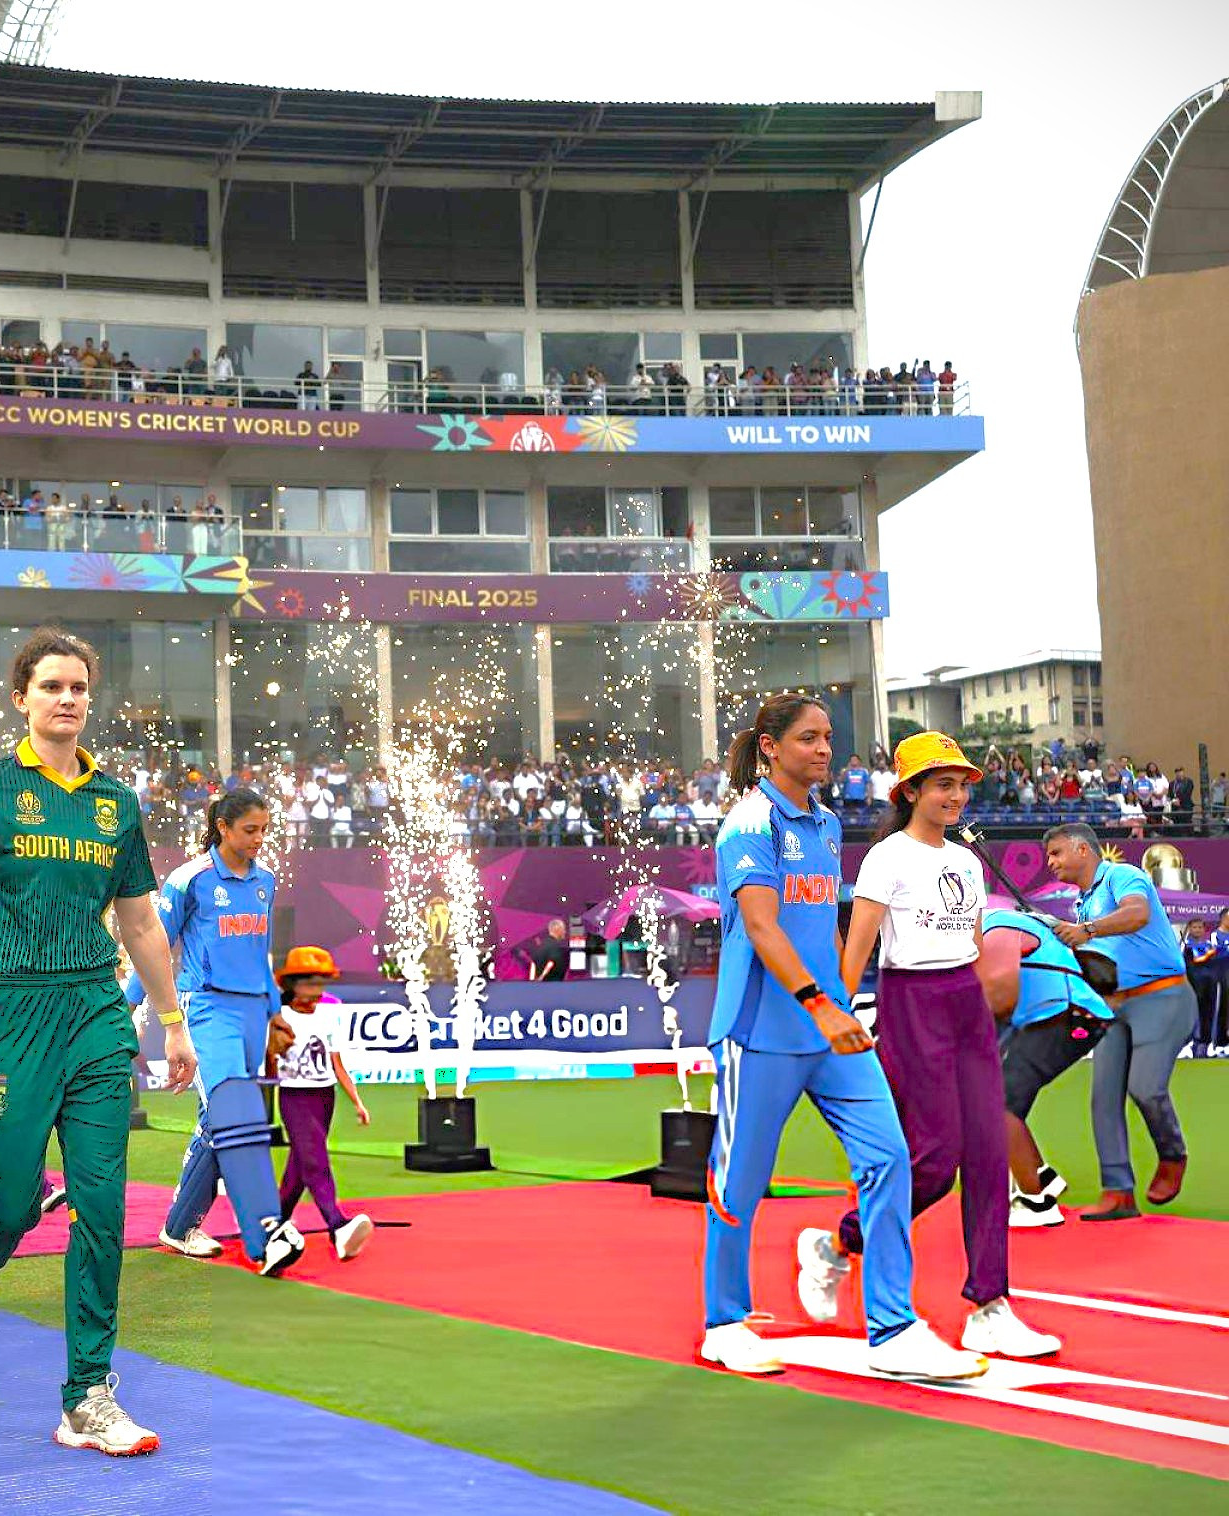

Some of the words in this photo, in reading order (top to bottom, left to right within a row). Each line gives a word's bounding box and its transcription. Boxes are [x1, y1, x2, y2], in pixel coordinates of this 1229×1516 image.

[27, 407, 132, 428] WOMEN'S
[137, 412, 227, 433] CRICKET
[233, 416, 312, 436] WORLD
[318, 420, 361, 438] CUP
[726, 426, 783, 444] WILL
[785, 426, 820, 444] TO
[823, 425, 871, 444] WIN
[407, 589, 474, 608] FINAL
[477, 589, 539, 608] 2025
[13, 834, 70, 860] SOUTH
[75, 839, 118, 868] AFRIC
[783, 873, 840, 905] INDI
[218, 913, 268, 938] INDIA
[348, 1010, 402, 1041] ICC
[525, 1009, 548, 1039] 4
[551, 1005, 628, 1039] Good
